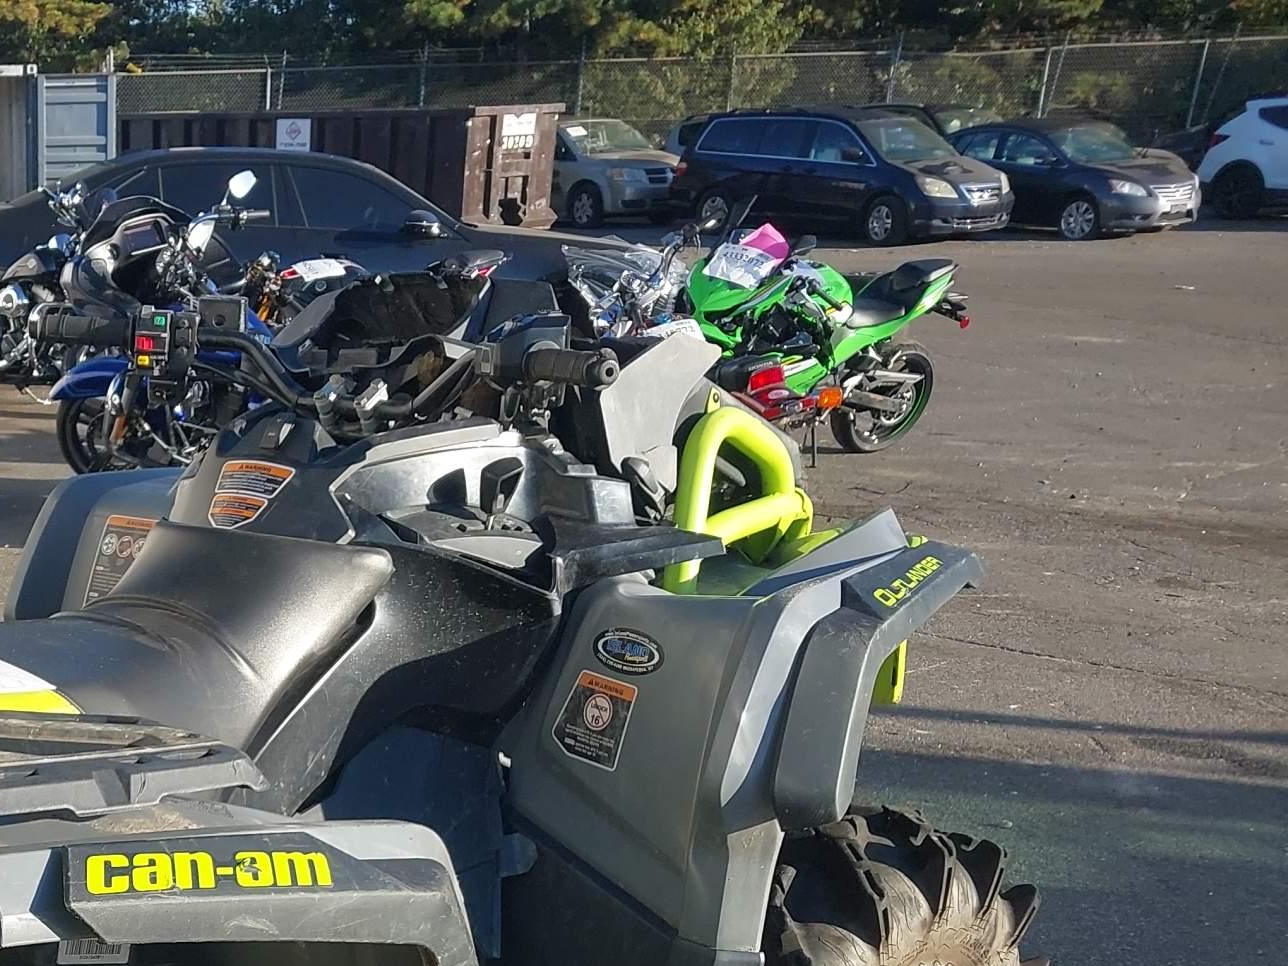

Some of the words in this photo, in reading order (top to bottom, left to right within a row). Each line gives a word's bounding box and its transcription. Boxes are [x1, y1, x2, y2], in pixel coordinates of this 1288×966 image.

[592, 680, 624, 696] WARNING
[590, 713, 600, 726] 16
[86, 851, 333, 895] can-am
